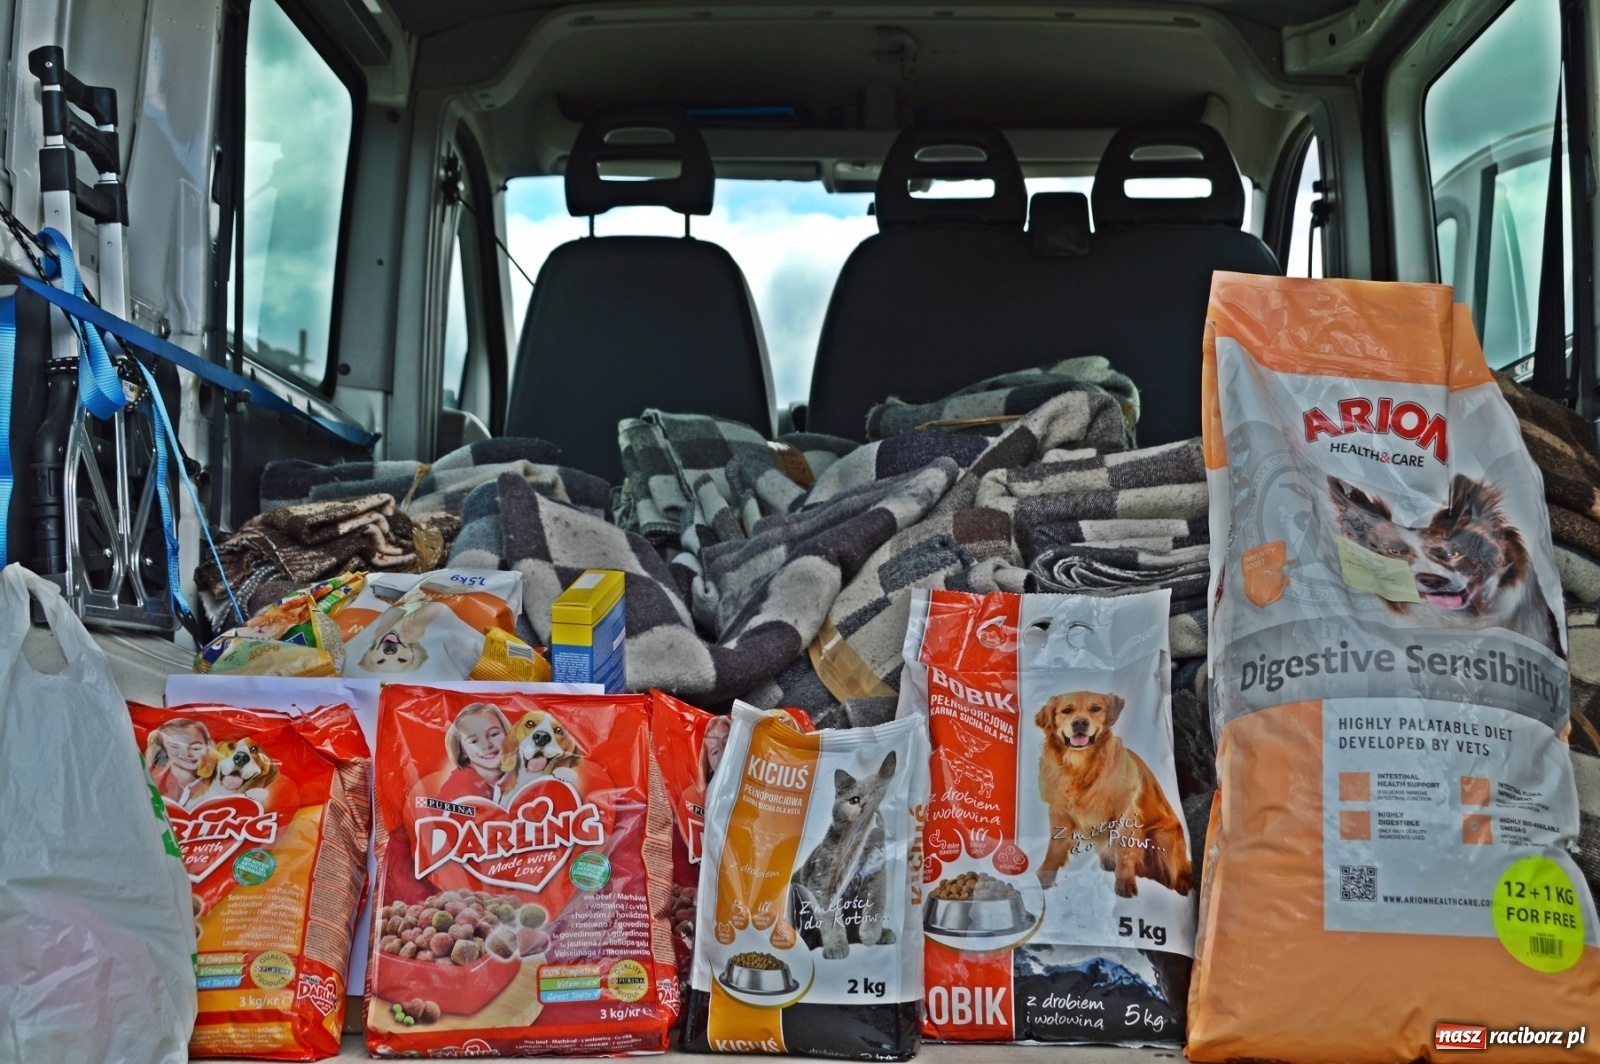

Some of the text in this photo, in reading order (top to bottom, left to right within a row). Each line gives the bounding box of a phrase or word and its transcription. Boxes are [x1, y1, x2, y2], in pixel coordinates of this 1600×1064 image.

[1303, 397, 1449, 465] ARION
[1330, 442, 1424, 467] HEALTH&CARE
[1239, 640, 1560, 713] Digestive Sensibility
[931, 666, 1016, 714] BOBIK
[930, 706, 1013, 744] KARMA SUCHA DLA PSA
[931, 694, 1014, 736] PEŁNOPORCJOWA
[1338, 717, 1512, 742] HIGHLY PALATABLE DIET
[1338, 736, 1490, 757] DEVELOPED BY VETS
[747, 754, 809, 790] KICIUŚ
[429, 799, 474, 816] PURINA
[941, 786, 1000, 811] drobiem
[170, 807, 278, 844] RLING
[193, 842, 223, 853] with
[415, 803, 604, 880] DARLING
[186, 854, 208, 864] ove
[488, 851, 556, 876] Made with
[514, 865, 544, 878] Love
[1504, 881, 1574, 905] 12 + 1 KG
[804, 919, 822, 930] do
[1506, 907, 1576, 929] FOR FREE
[1118, 917, 1167, 945] 5 kg
[615, 963, 642, 975] QUALITY
[847, 978, 886, 997] 2 kg
[239, 996, 246, 1007] 3
[928, 986, 1007, 1026] OBIK
[1042, 993, 1105, 1011] drobiem
[600, 1009, 607, 1019] 3
[1034, 1012, 1105, 1030] wołowiną
